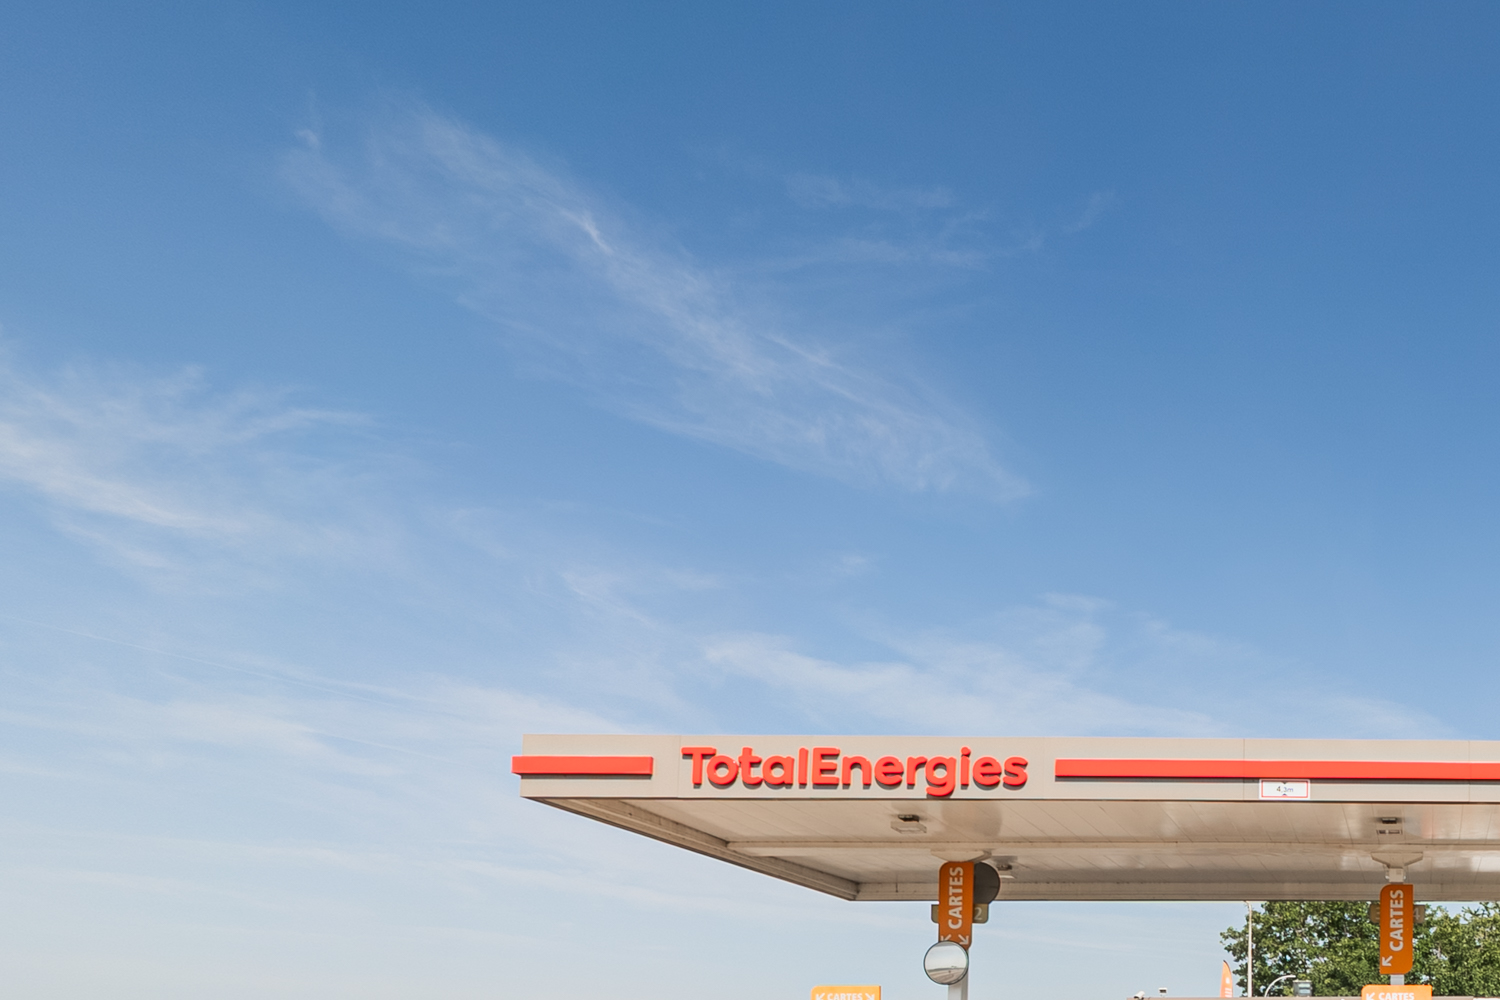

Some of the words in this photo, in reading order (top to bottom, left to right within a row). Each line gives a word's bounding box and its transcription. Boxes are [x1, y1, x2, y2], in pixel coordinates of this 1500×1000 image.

[681, 747, 1029, 798] TotalEnergies
[948, 866, 964, 930] CARTES
[974, 906, 983, 921] 2
[1389, 889, 1404, 952] CARTES
